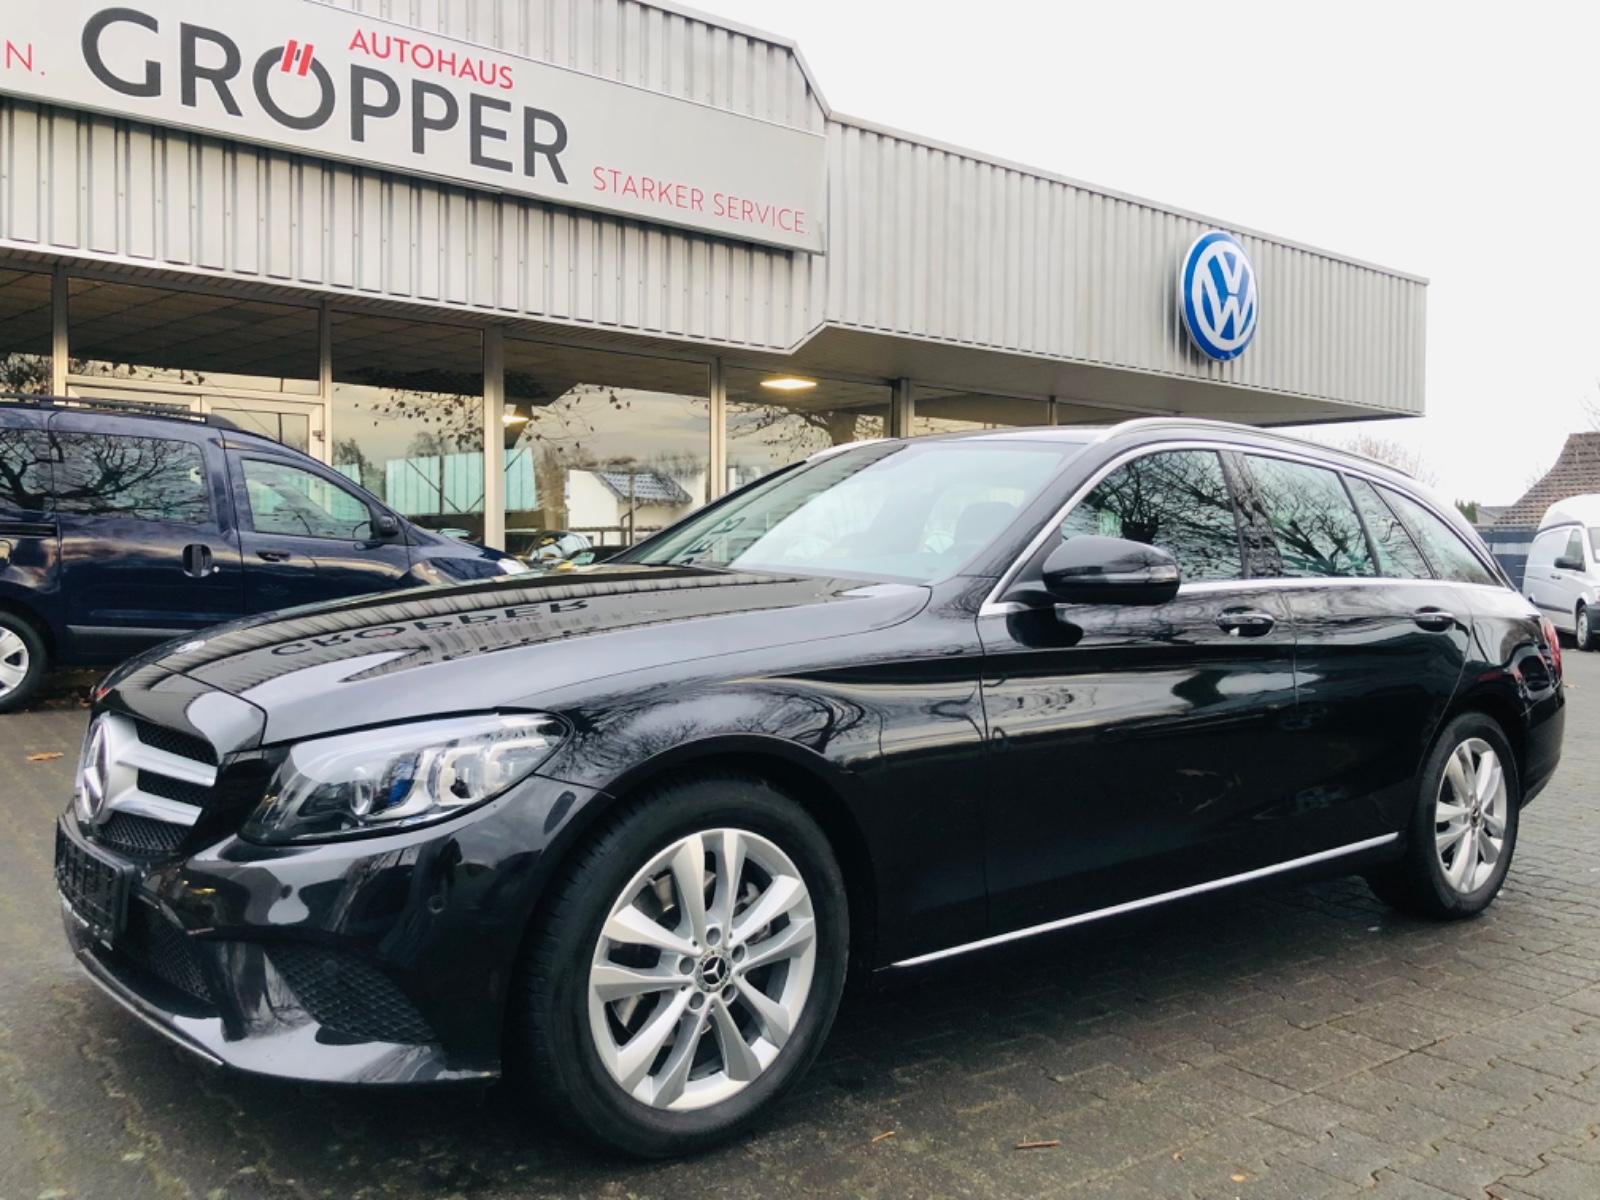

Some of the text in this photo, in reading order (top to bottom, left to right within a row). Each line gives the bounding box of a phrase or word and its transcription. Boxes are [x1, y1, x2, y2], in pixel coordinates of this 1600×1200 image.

[81, 7, 568, 185] GRÖPPER
[349, 29, 513, 90] AUTOHAUS
[592, 166, 810, 236] STARKER SERVICE.
[1191, 239, 1257, 351] VW
